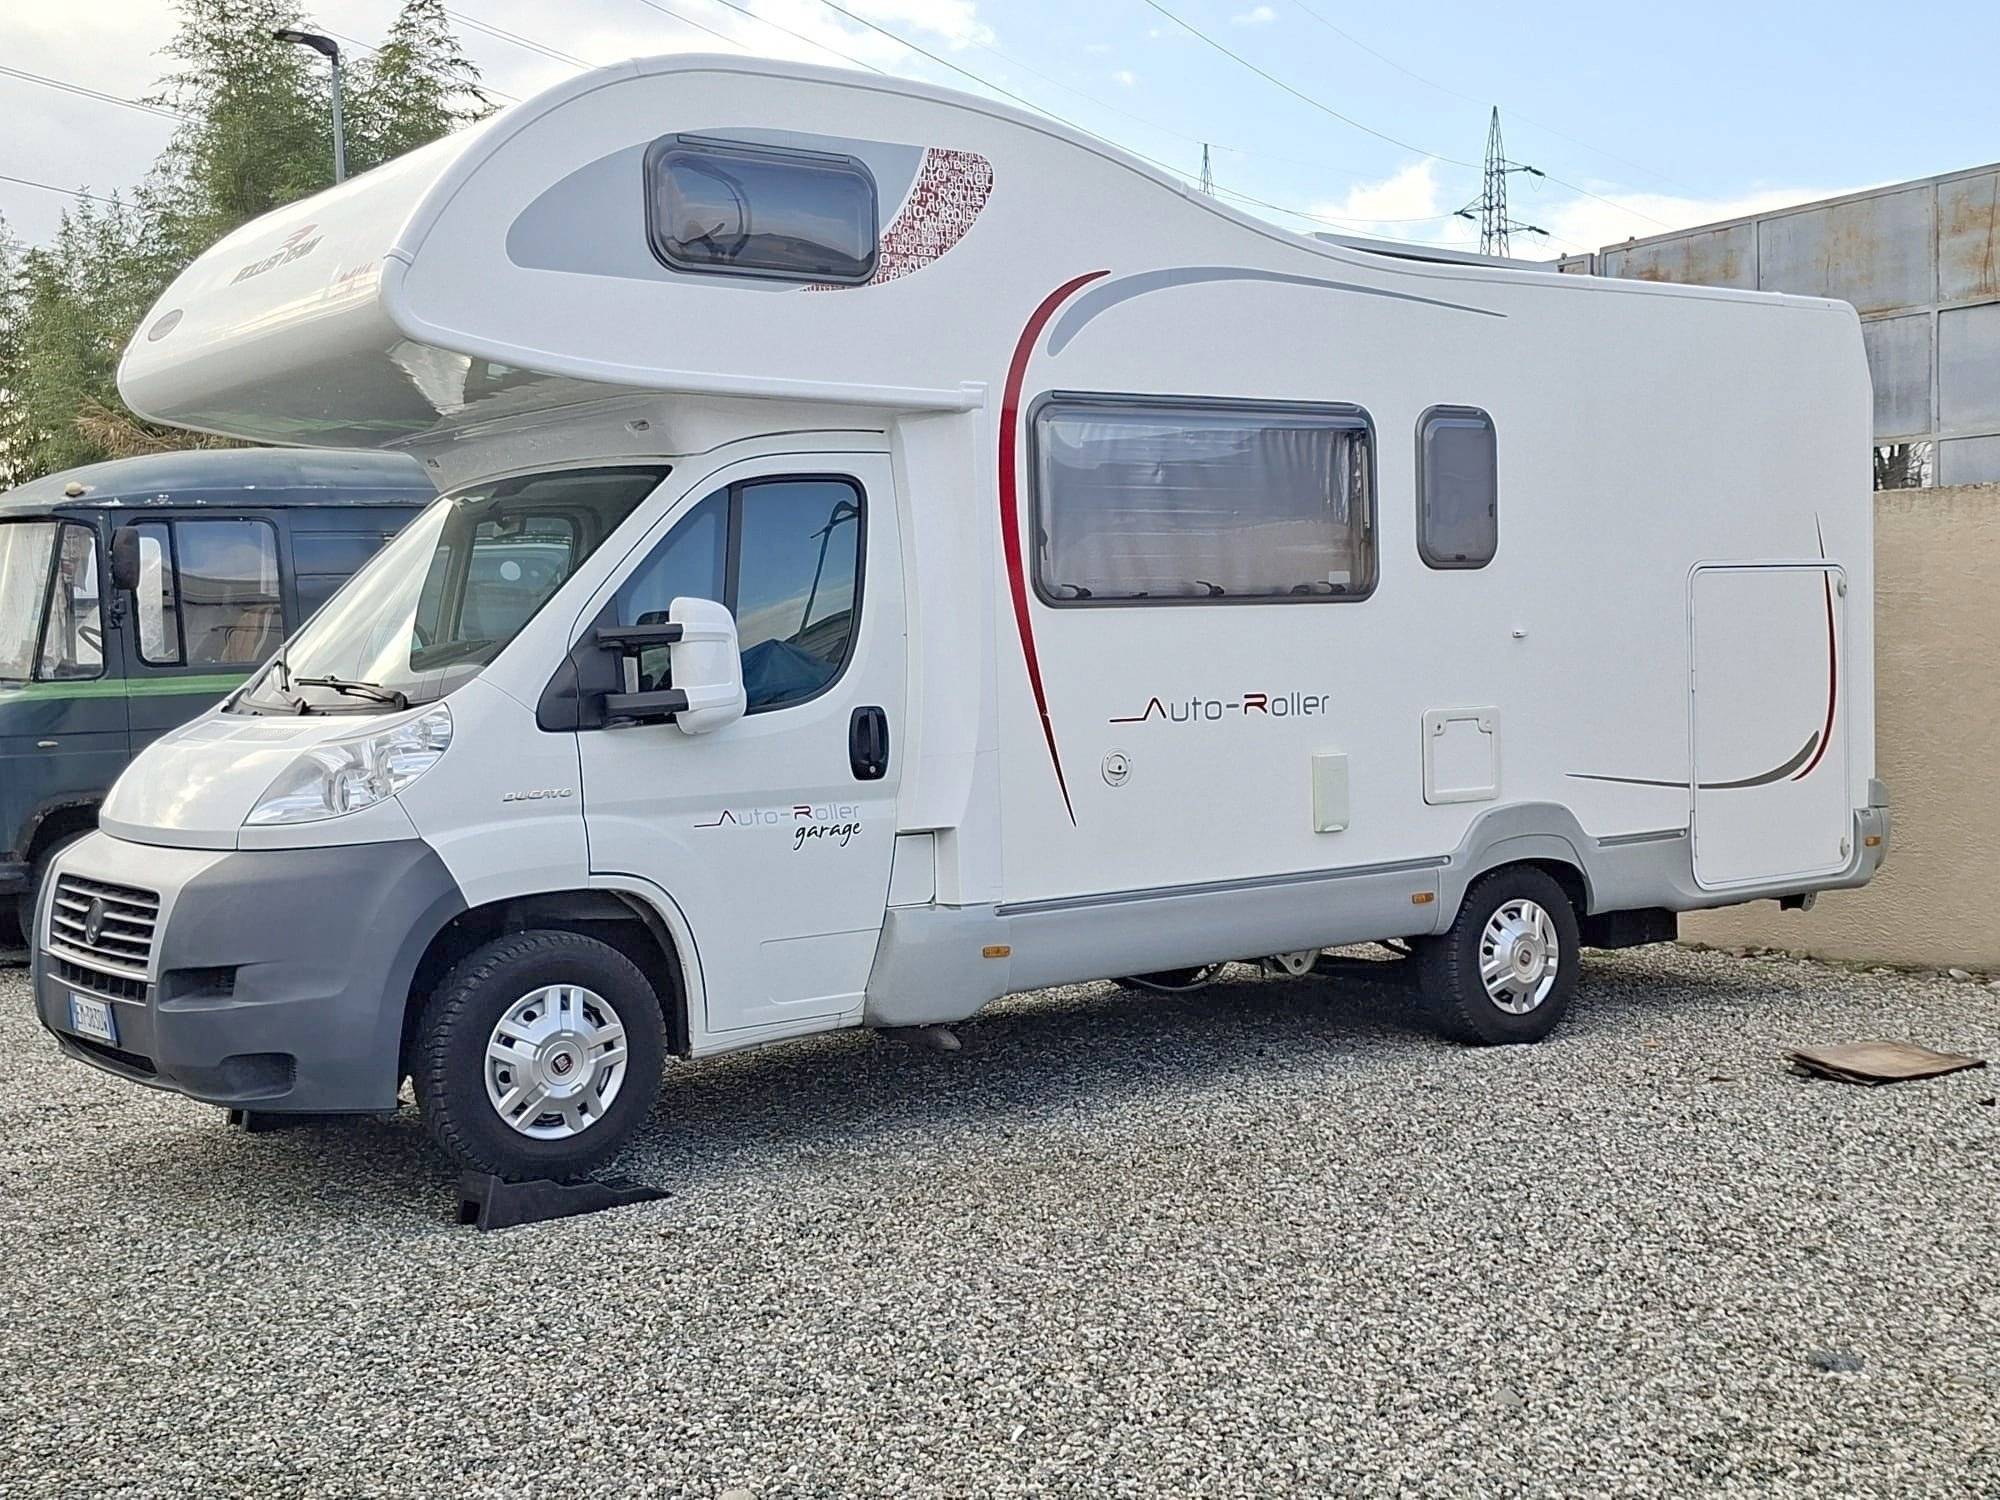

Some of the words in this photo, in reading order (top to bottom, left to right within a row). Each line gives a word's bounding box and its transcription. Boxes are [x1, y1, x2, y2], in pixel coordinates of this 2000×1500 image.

[1109, 692, 1330, 723] Auto-Roller
[503, 787, 572, 802] DUCATO
[693, 804, 860, 827] Auto-Roller
[793, 822, 862, 850] garage
